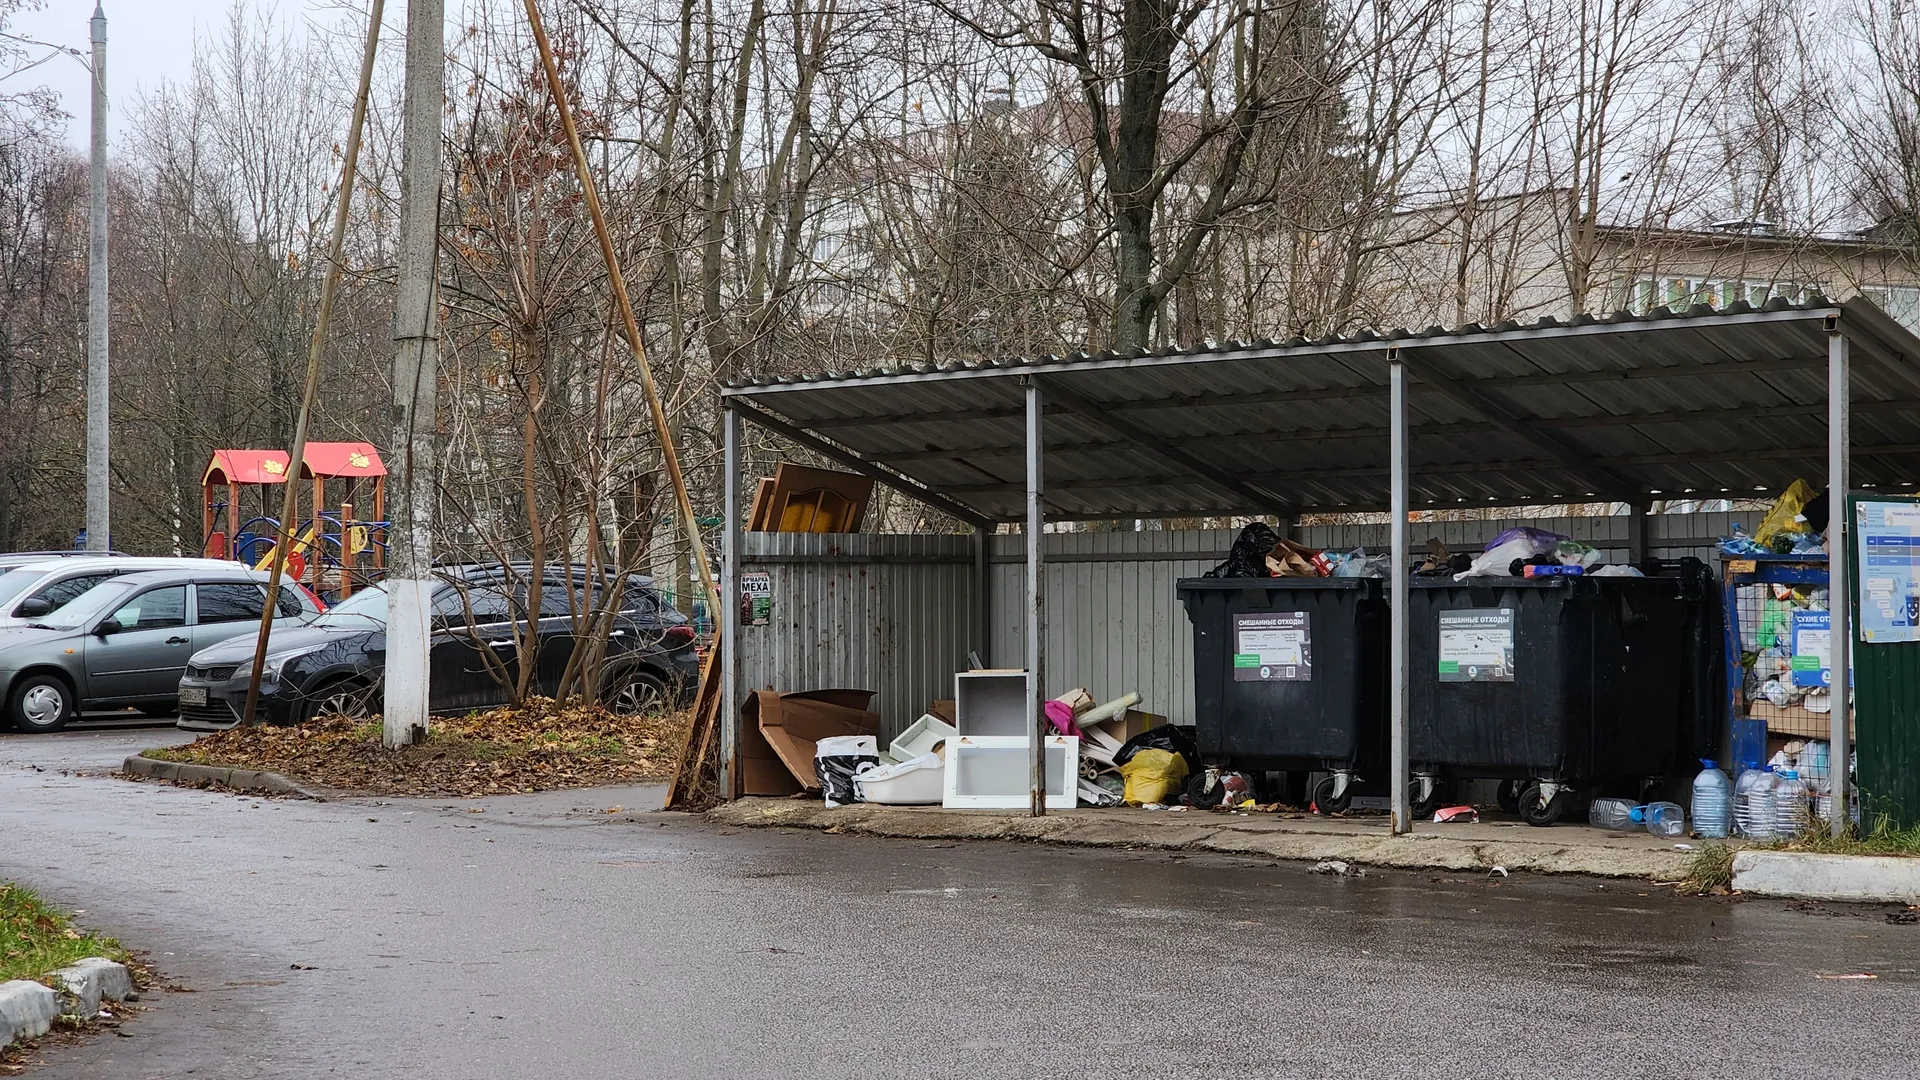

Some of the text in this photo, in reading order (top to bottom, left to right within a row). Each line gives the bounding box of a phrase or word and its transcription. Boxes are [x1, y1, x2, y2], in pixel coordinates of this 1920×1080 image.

[741, 583, 769, 591] МЕХА
[1277, 618, 1304, 626] ОТХОДЫ
[1440, 616, 1510, 624] СМЕШАННЫЕ ОТХОДЫ
